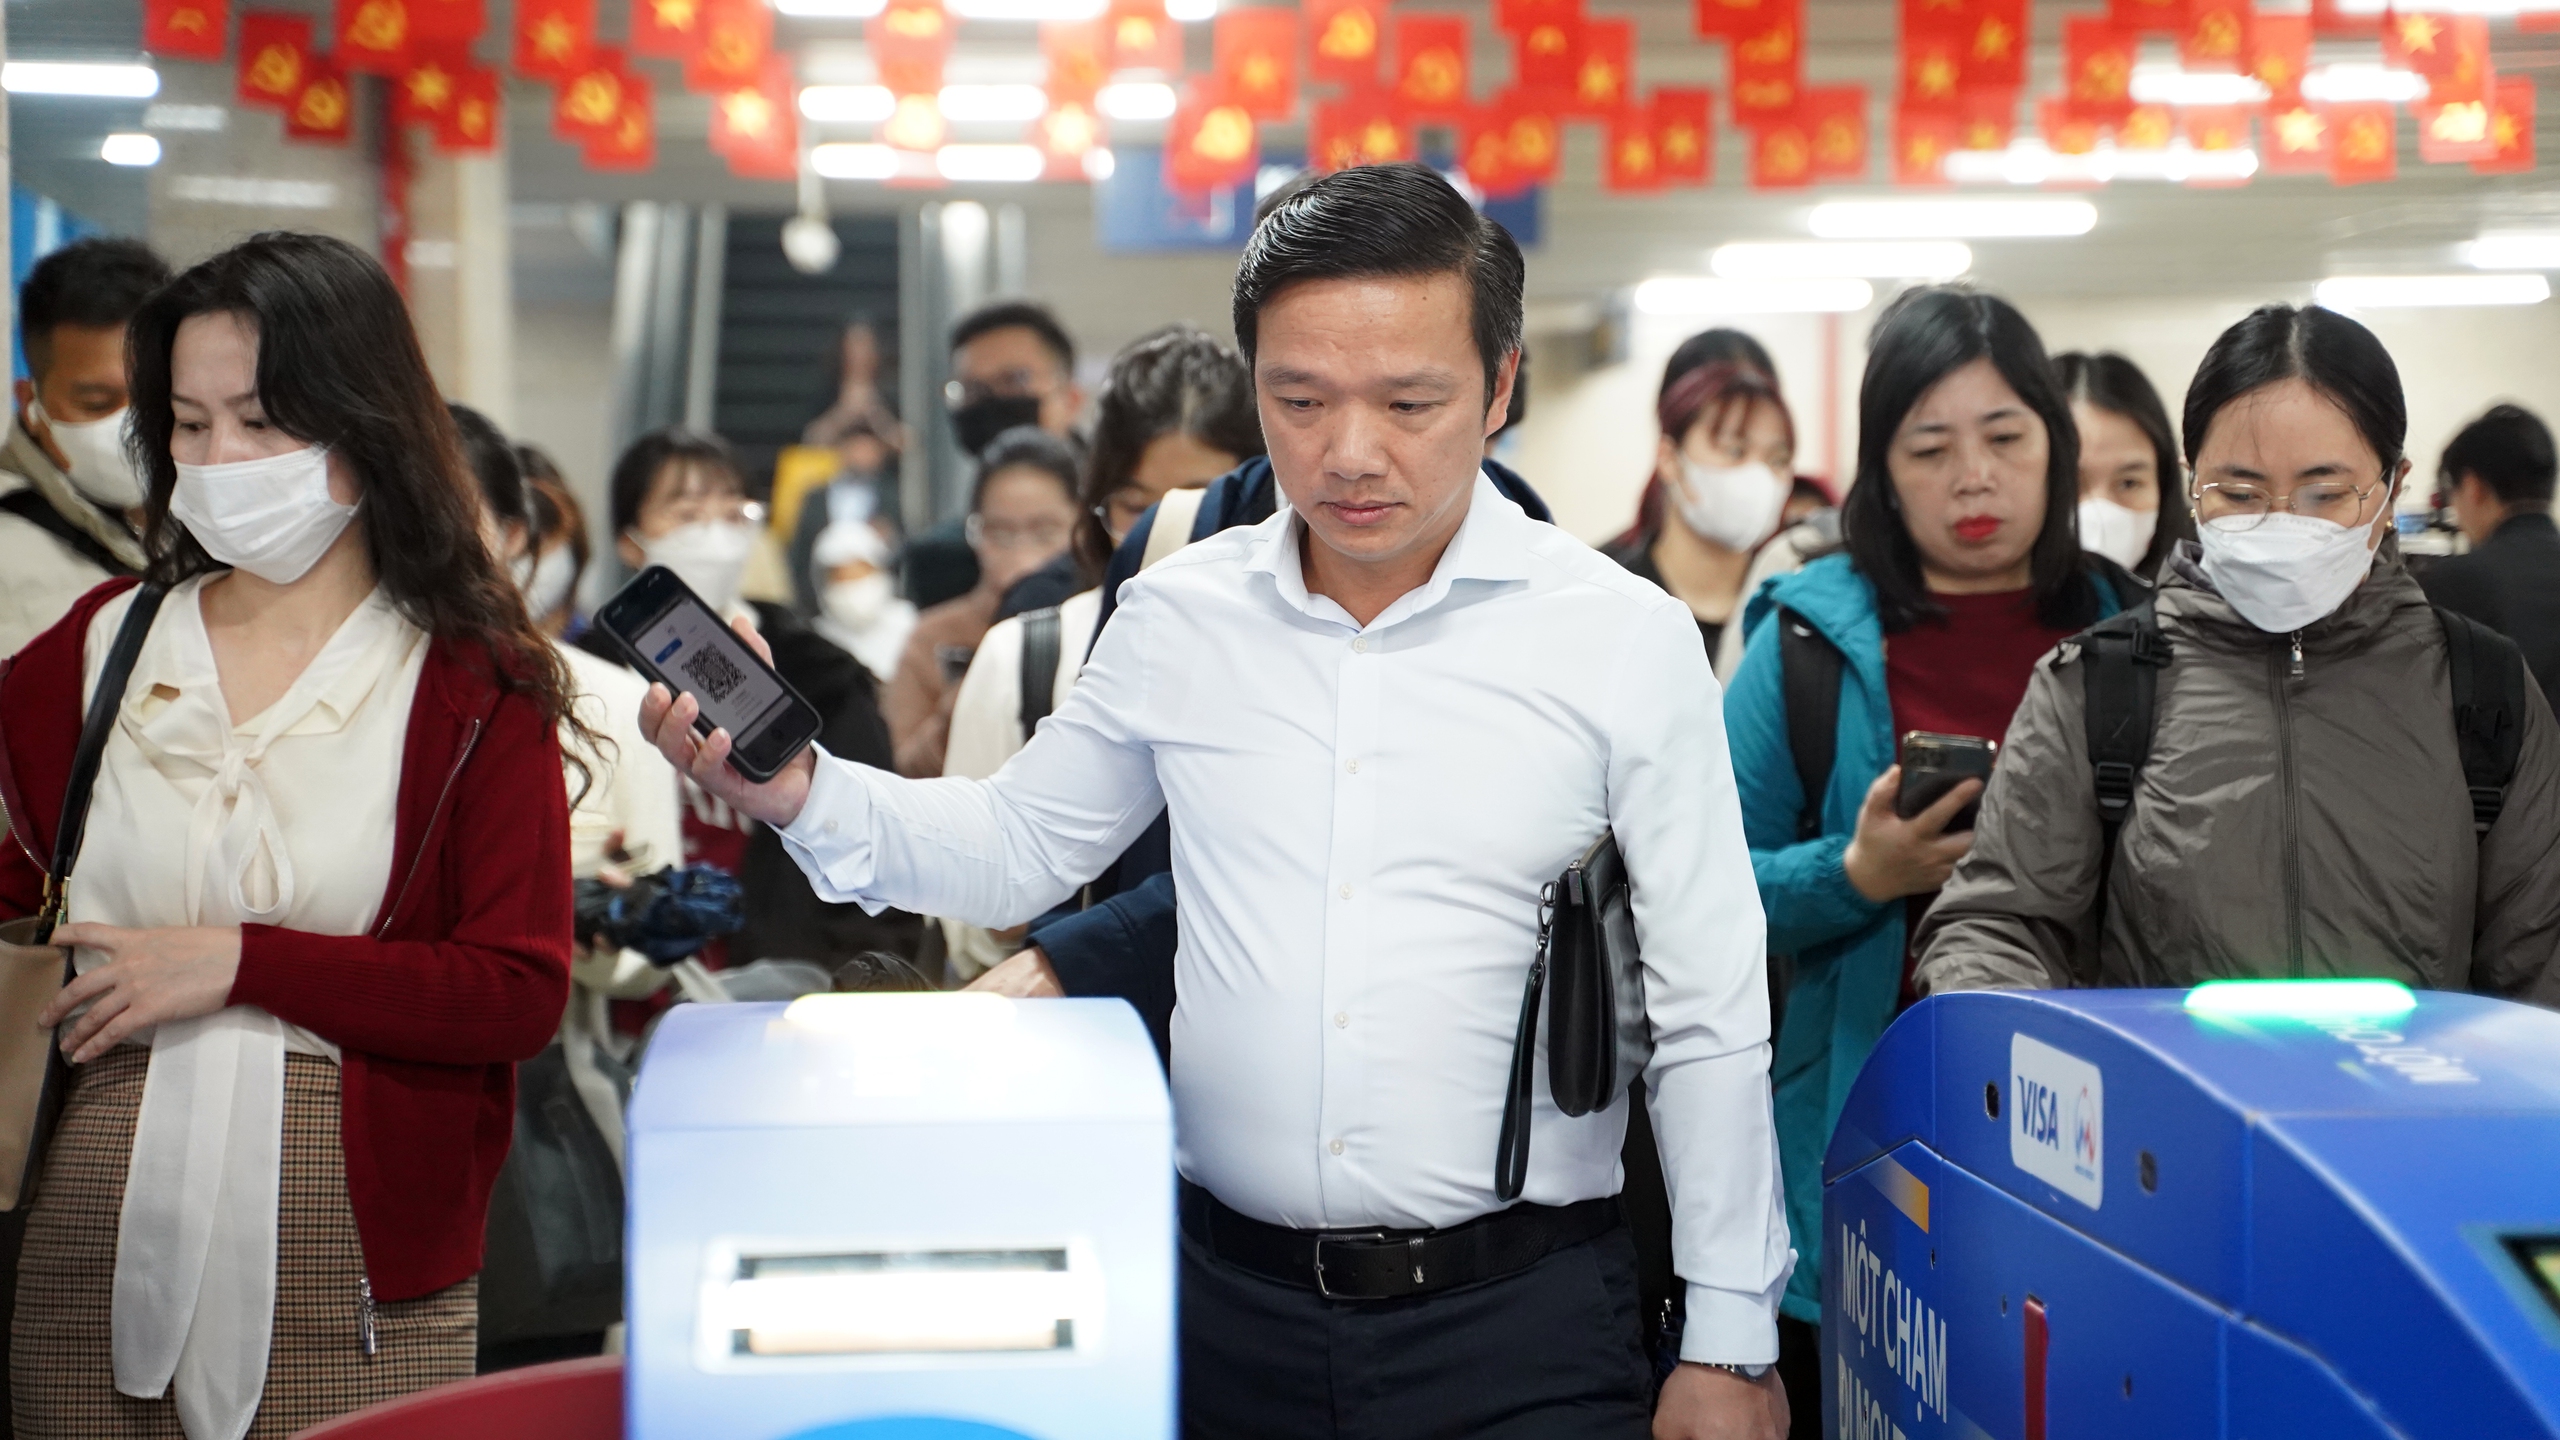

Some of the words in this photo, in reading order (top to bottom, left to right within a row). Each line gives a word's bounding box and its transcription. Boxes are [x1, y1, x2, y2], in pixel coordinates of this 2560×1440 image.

[2017, 1074, 2059, 1151] VISA
[1842, 1218, 1881, 1359] MỘT
[1883, 1269, 1947, 1424] CHẠM
